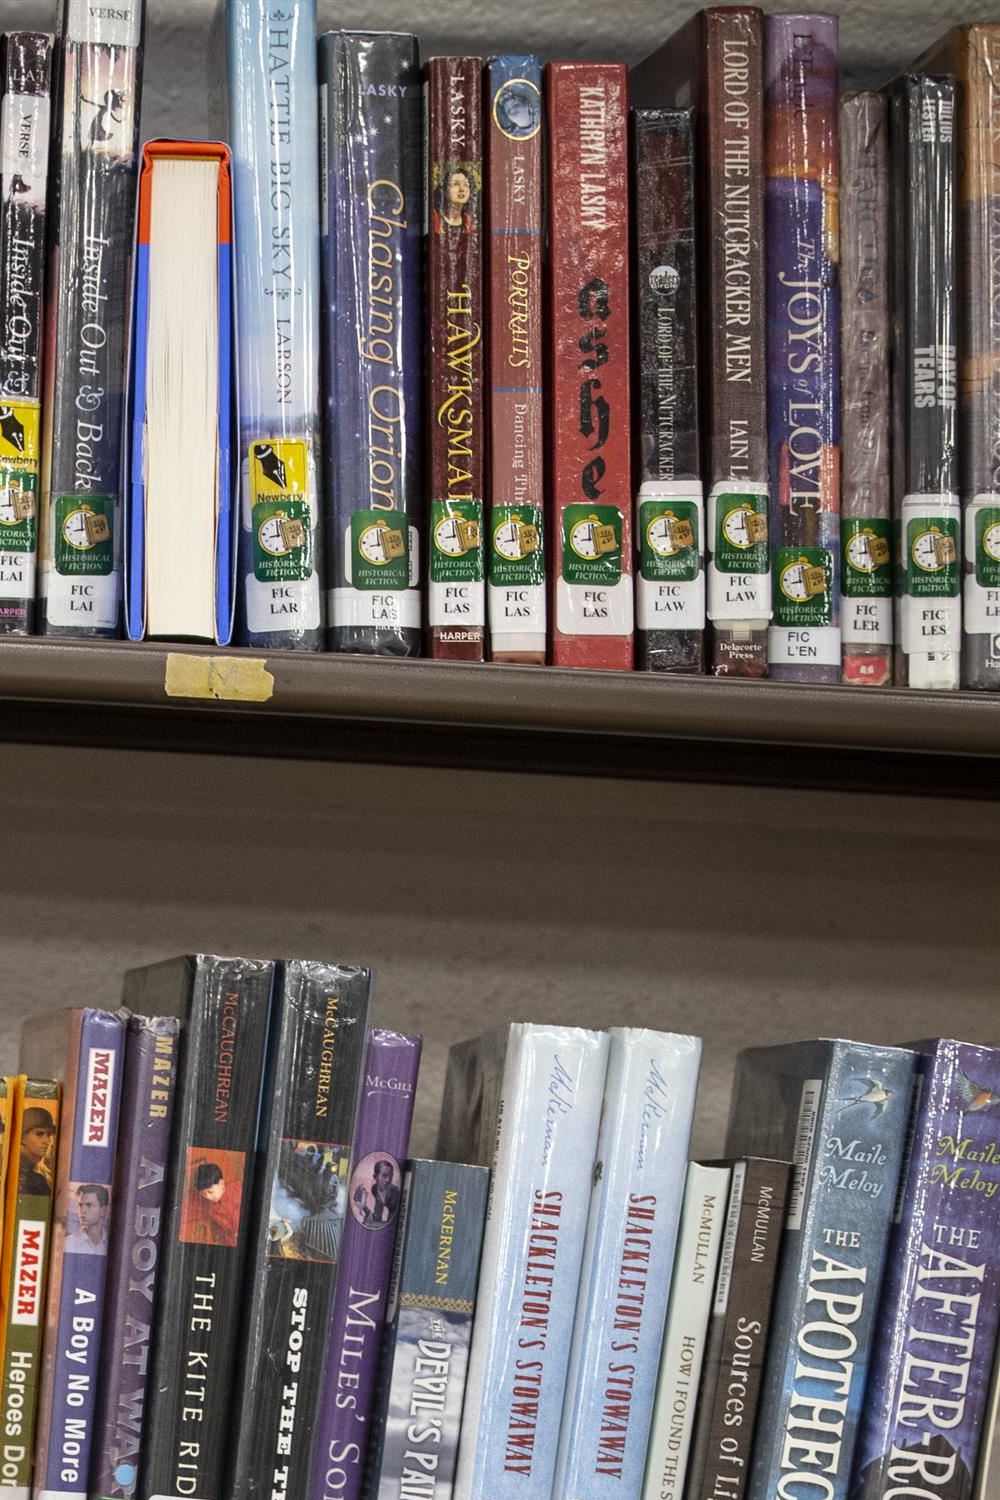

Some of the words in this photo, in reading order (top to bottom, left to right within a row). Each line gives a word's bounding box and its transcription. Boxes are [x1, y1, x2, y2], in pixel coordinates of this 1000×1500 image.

[268, 28, 290, 150] HATTIE
[358, 85, 407, 97] LASKY
[723, 40, 749, 95] LORD
[450, 75, 466, 150] LASKY
[579, 85, 604, 167] KATHRYN
[723, 97, 749, 128] OF
[724, 134, 750, 175] THE
[269, 162, 292, 213] BIG
[580, 174, 607, 230] LASKY
[271, 223, 293, 287] SKY
[359, 181, 407, 364] Chasing
[725, 187, 751, 328] NUTCRACKER
[507, 251, 531, 369] PORTRAITS
[779, 273, 823, 375] JOYS
[276, 317, 292, 404] LARSON
[726, 333, 752, 385] MEN
[788, 402, 823, 515] LOVE
[70, 585, 94, 597] FIC
[70, 600, 94, 612] LAI
[440, 631, 480, 642] HARPER
[786, 633, 810, 642] FIC
[786, 646, 817, 656] L'EN
[90, 1050, 110, 1144] MAZER
[821, 1163, 883, 1197] Meloy
[825, 1137, 886, 1167] Maile
[823, 1229, 861, 1249] THE
[74, 1287, 96, 1305] A
[518, 1190, 563, 1353] SHACKLETON'S
[191, 1272, 216, 1333] THE
[284, 1287, 310, 1372] STOP
[70, 1317, 95, 1364] Boy
[66, 1373, 90, 1407] No
[185, 1350, 211, 1423] KITE
[726, 1318, 762, 1428] Sources
[504, 1358, 543, 1480] STOWAWAY
[60, 1418, 85, 1482] More
